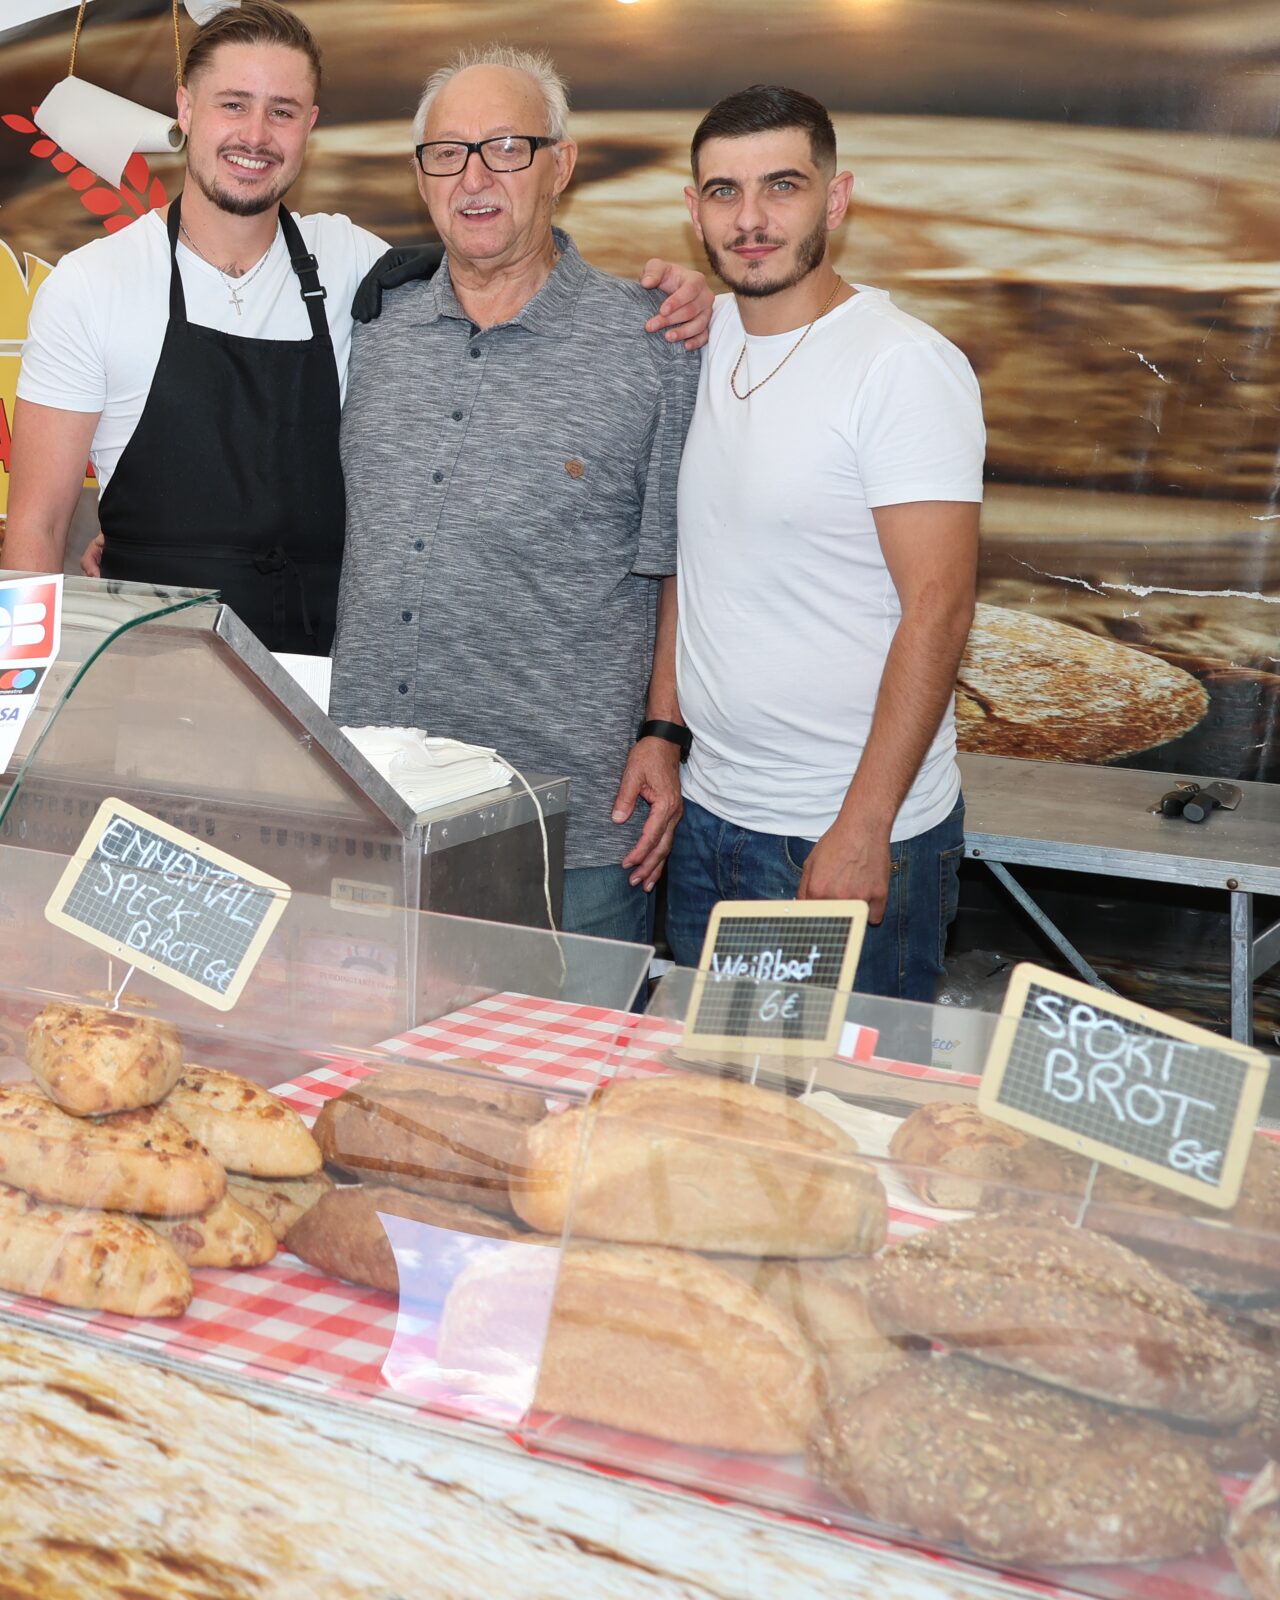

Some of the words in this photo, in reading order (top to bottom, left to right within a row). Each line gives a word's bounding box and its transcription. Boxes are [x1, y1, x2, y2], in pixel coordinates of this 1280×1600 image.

[126, 919, 210, 967] BROT
[203, 959, 237, 992] 6€
[759, 990, 800, 1022] 6€
[1035, 995, 1200, 1083] SPORT
[1044, 1048, 1217, 1139] BROT
[1167, 1139, 1222, 1187] 6€
